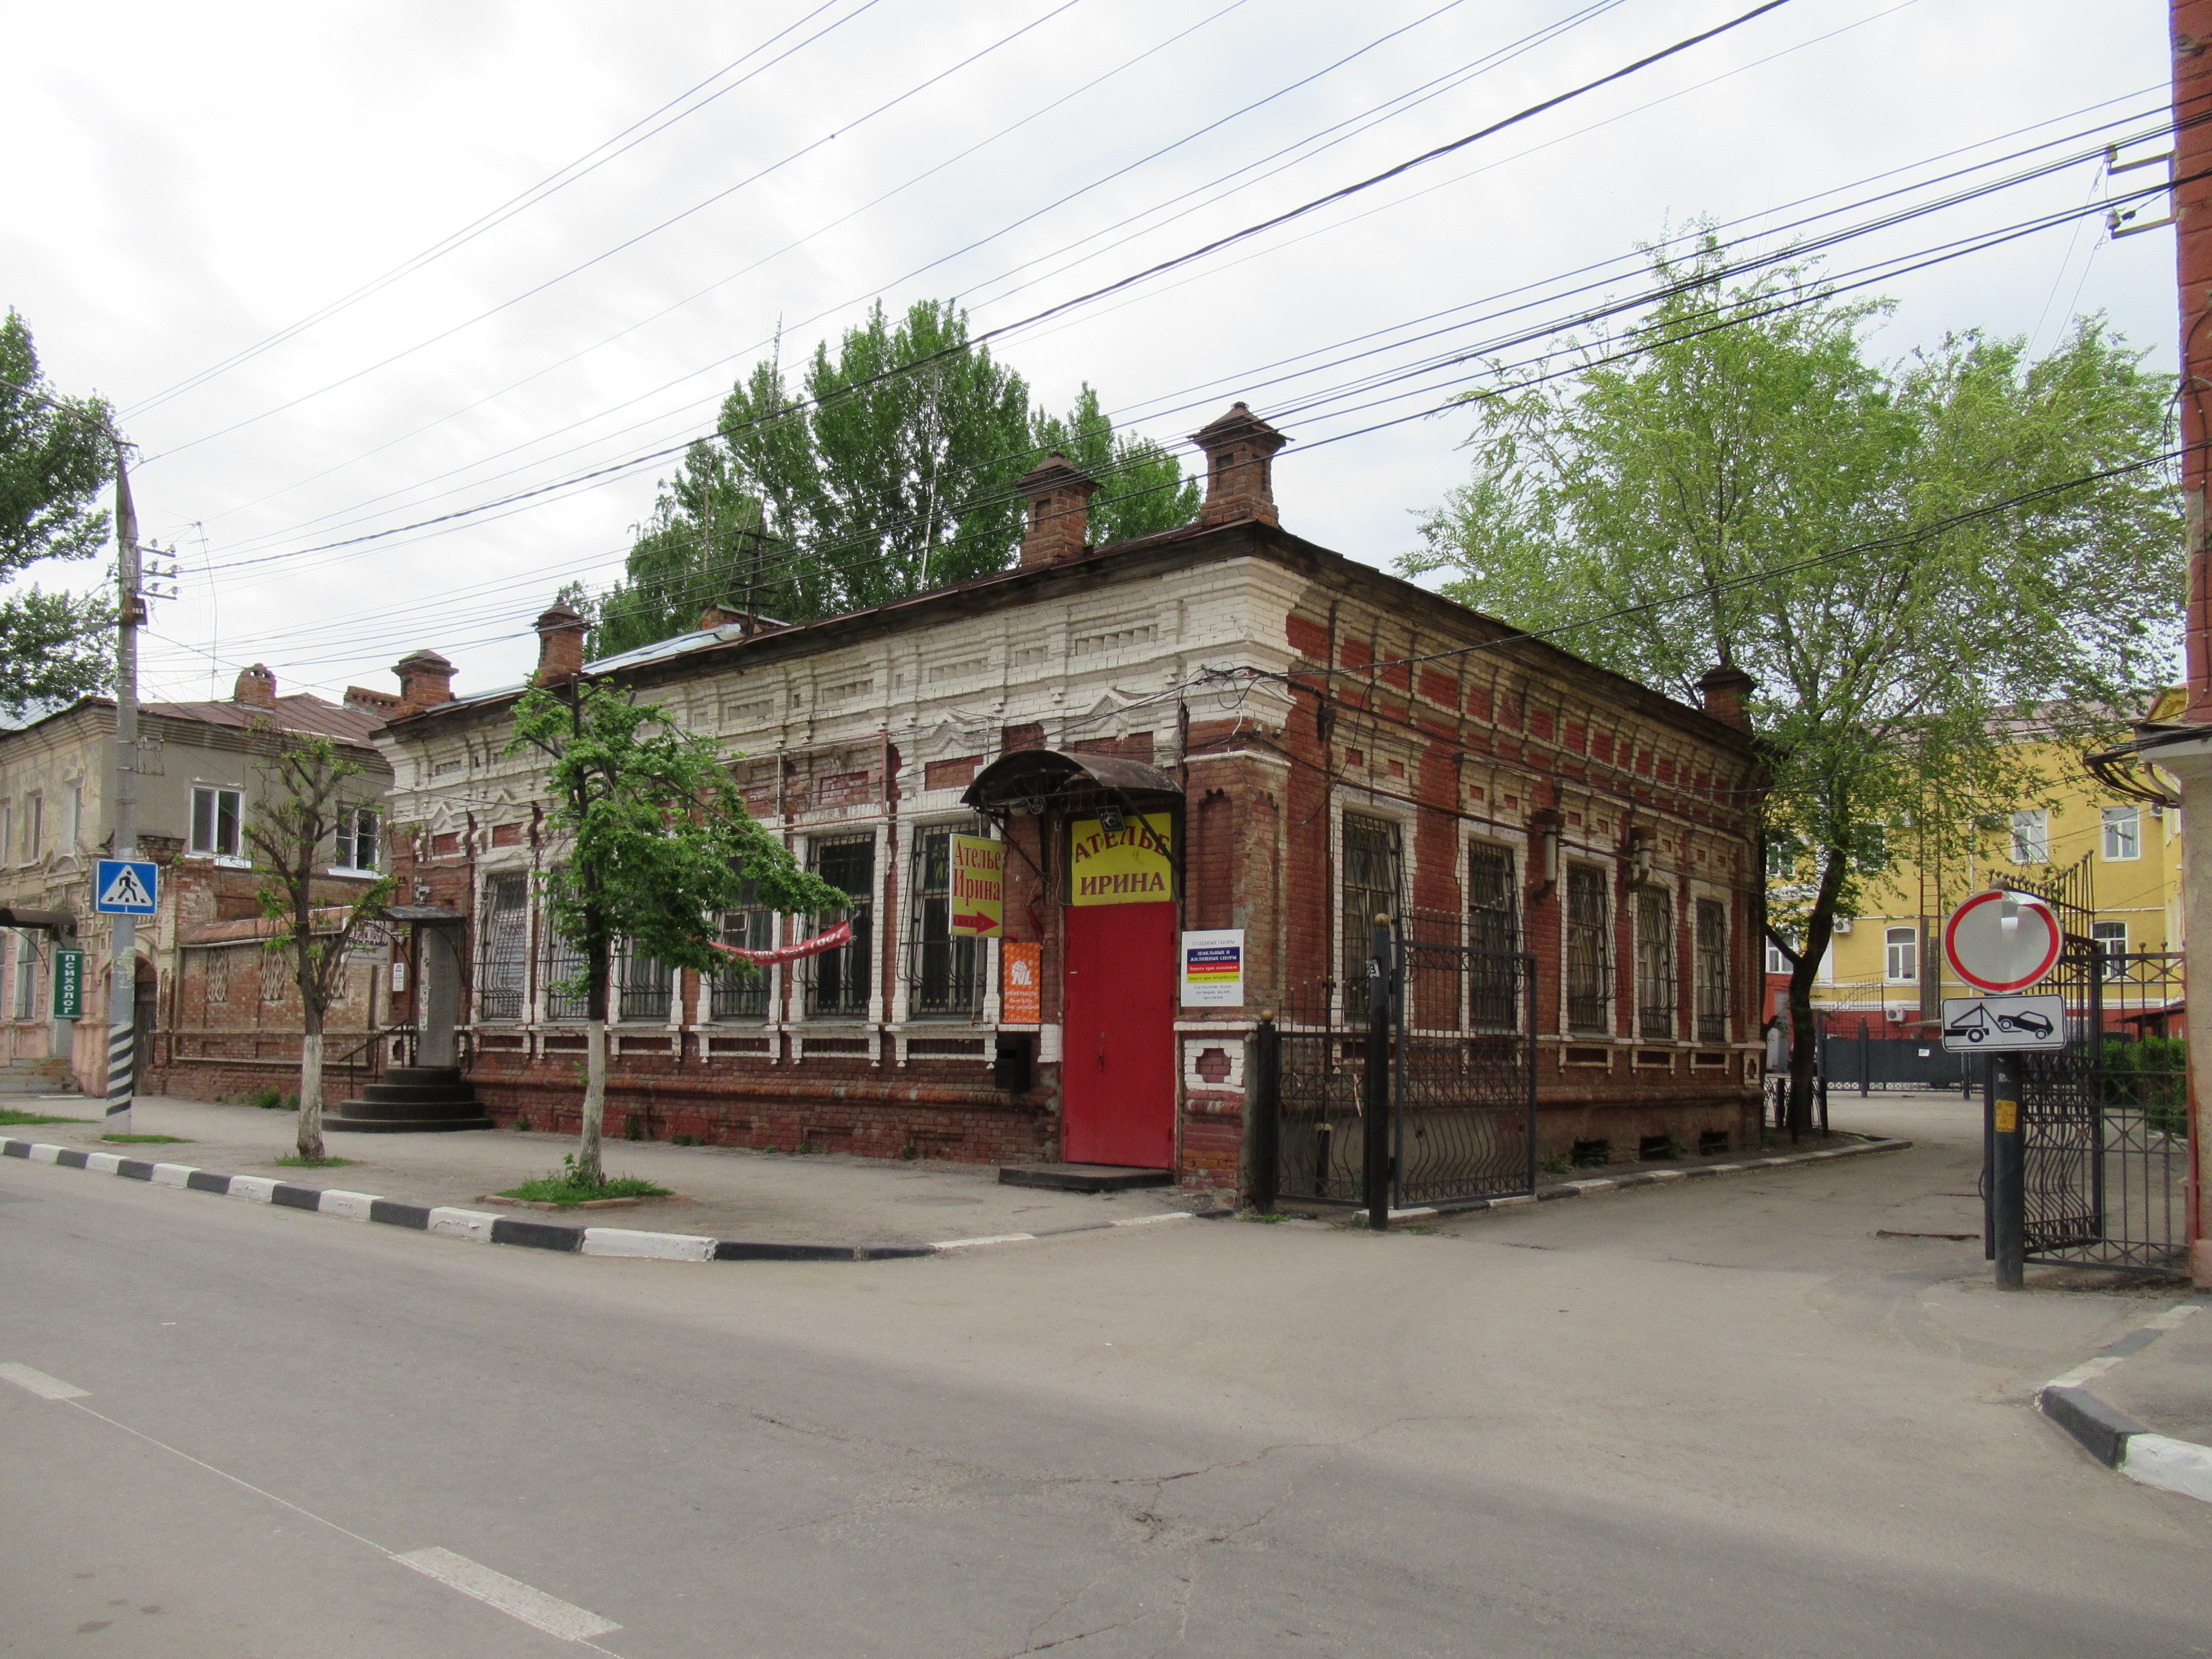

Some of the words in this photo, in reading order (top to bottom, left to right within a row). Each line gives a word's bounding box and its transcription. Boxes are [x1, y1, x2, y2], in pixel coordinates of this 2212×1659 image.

[953, 840, 1001, 870] Ателье
[1075, 826, 1170, 864] АТЕЛЬЕ
[953, 868, 1000, 907] Ирина
[1080, 872, 1165, 895] ИРИНА
[63, 955, 75, 1014] ПСИХОЛОГ
[1012, 970, 1033, 985] NL
